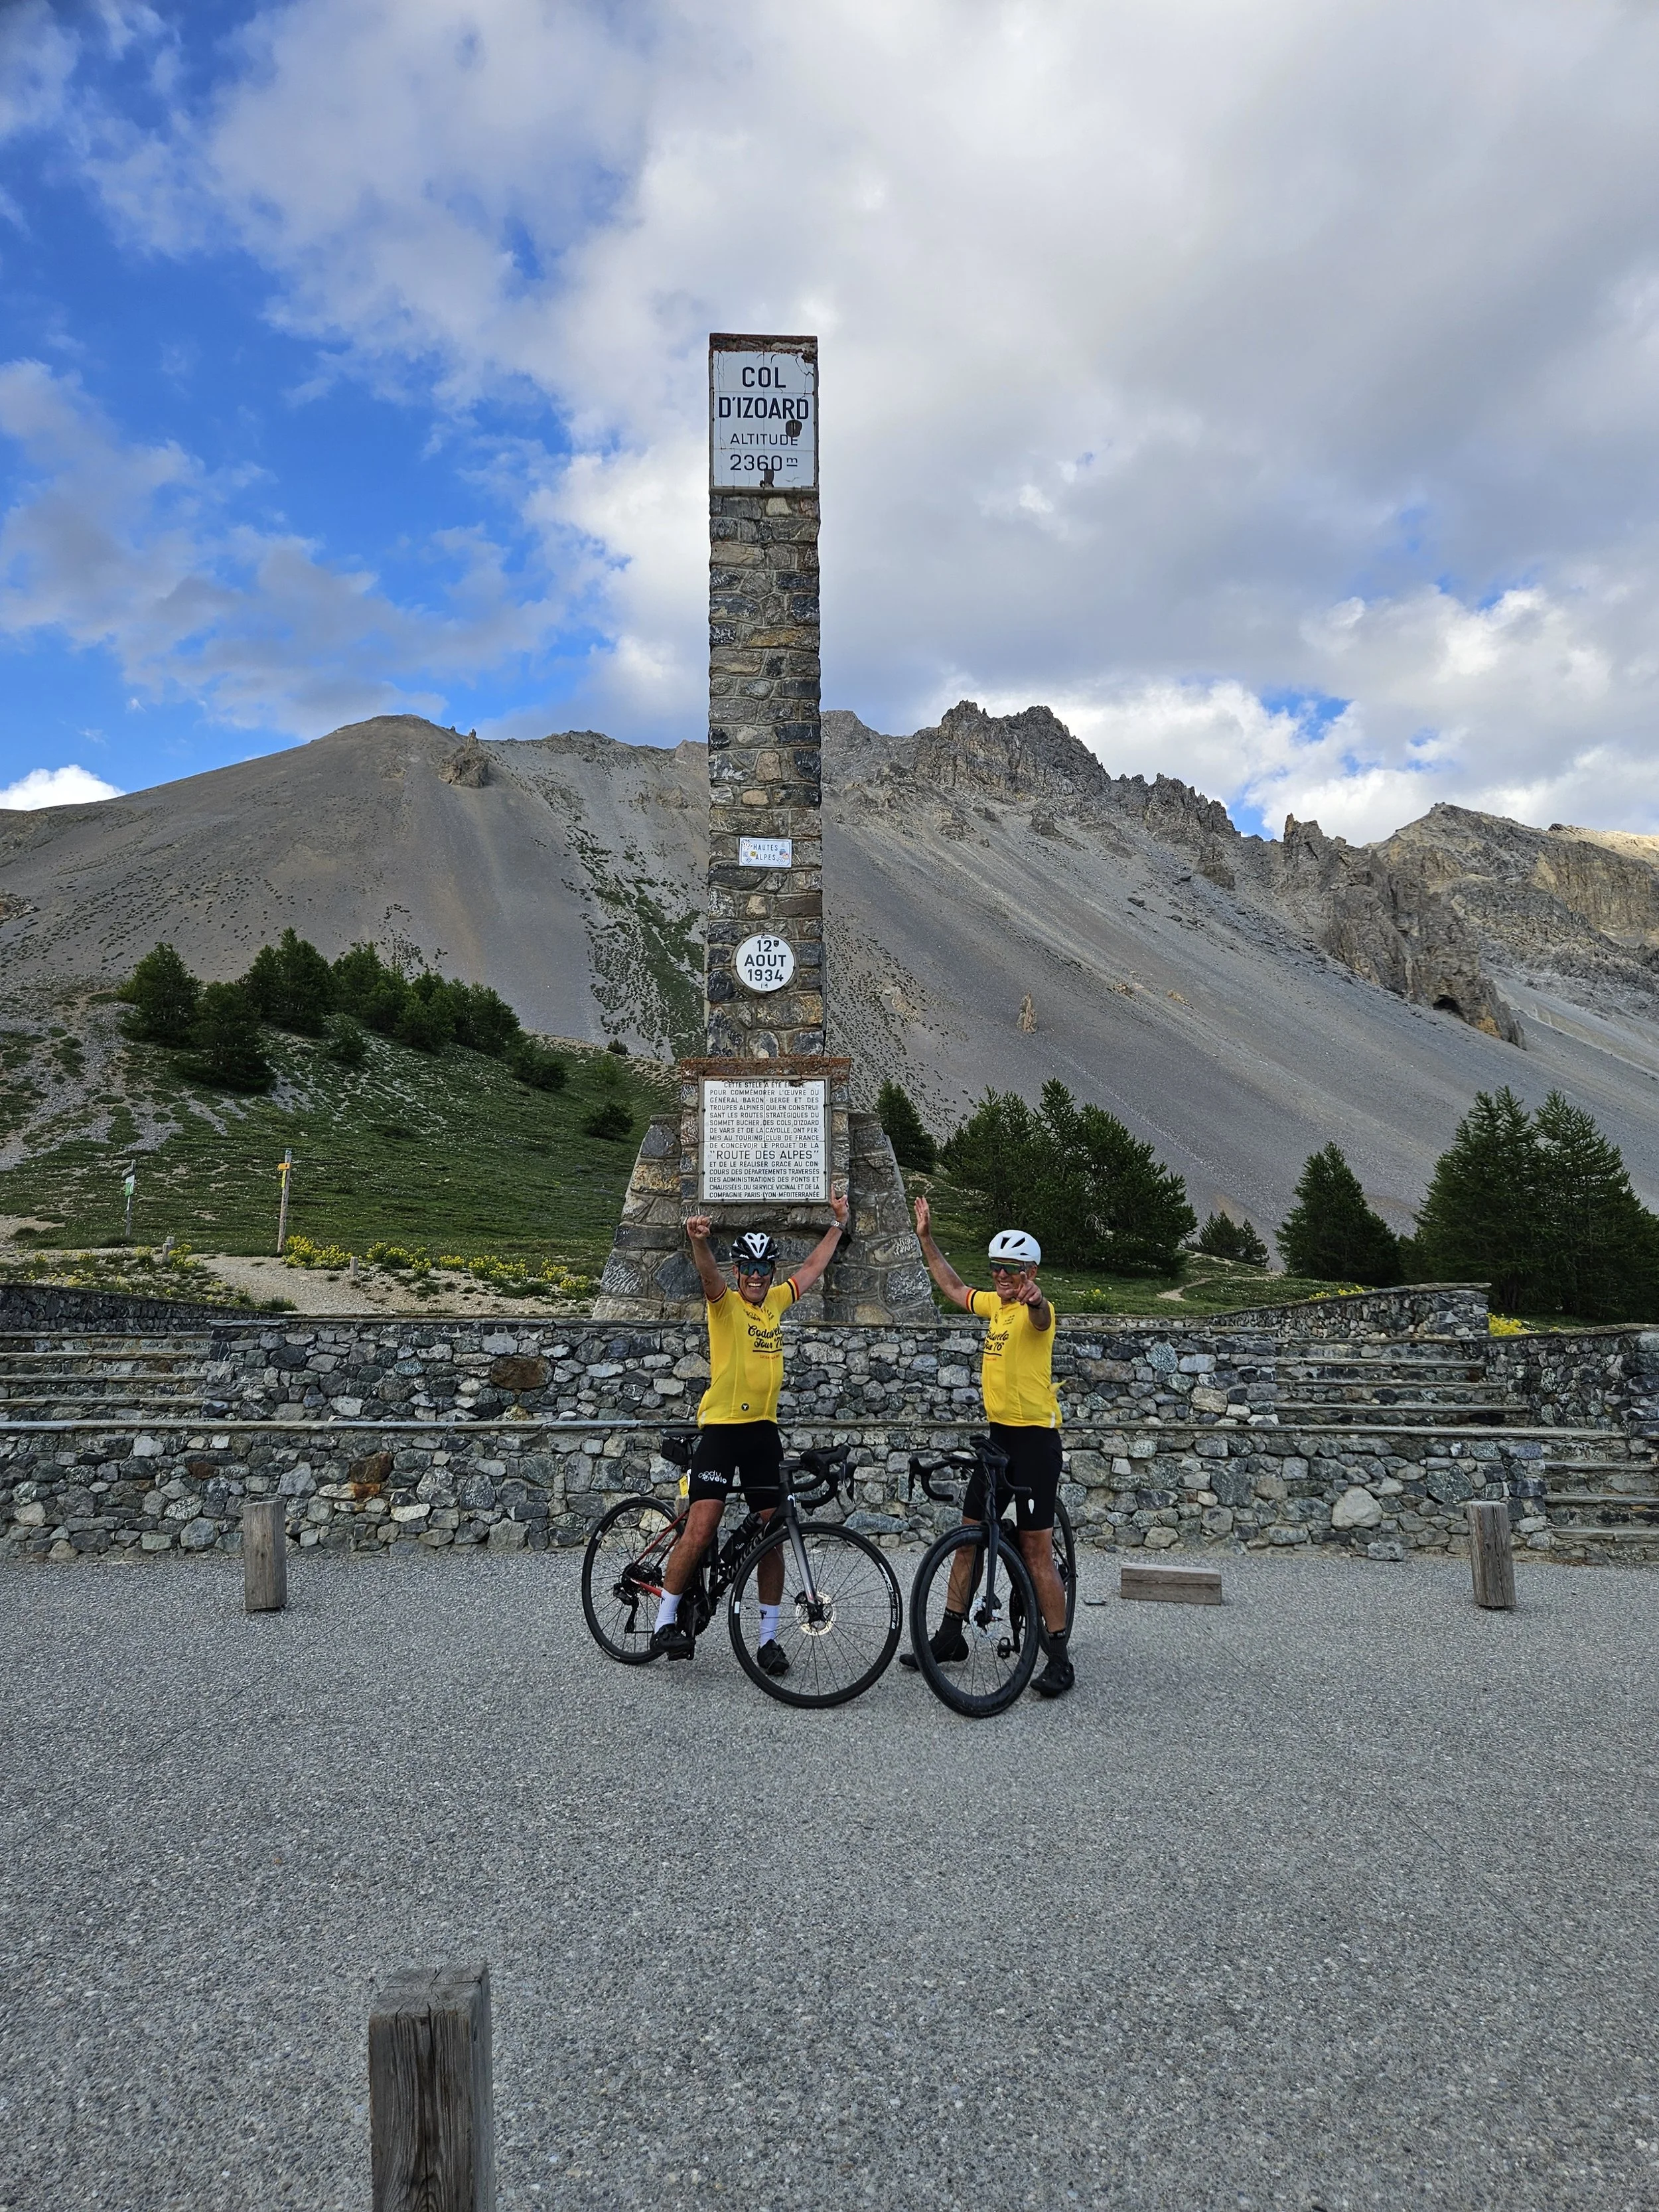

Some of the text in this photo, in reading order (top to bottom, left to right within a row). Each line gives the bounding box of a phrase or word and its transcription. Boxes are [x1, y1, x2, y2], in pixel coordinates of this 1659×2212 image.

[742, 366, 786, 388] COL
[719, 396, 809, 419] D'IZOARD
[730, 433, 798, 446] ALTITUDE
[744, 954, 786, 967] AOUT
[748, 969, 784, 982] 1934
[755, 1150, 775, 1159] DES
[754, 1338, 773, 1349] Tour
